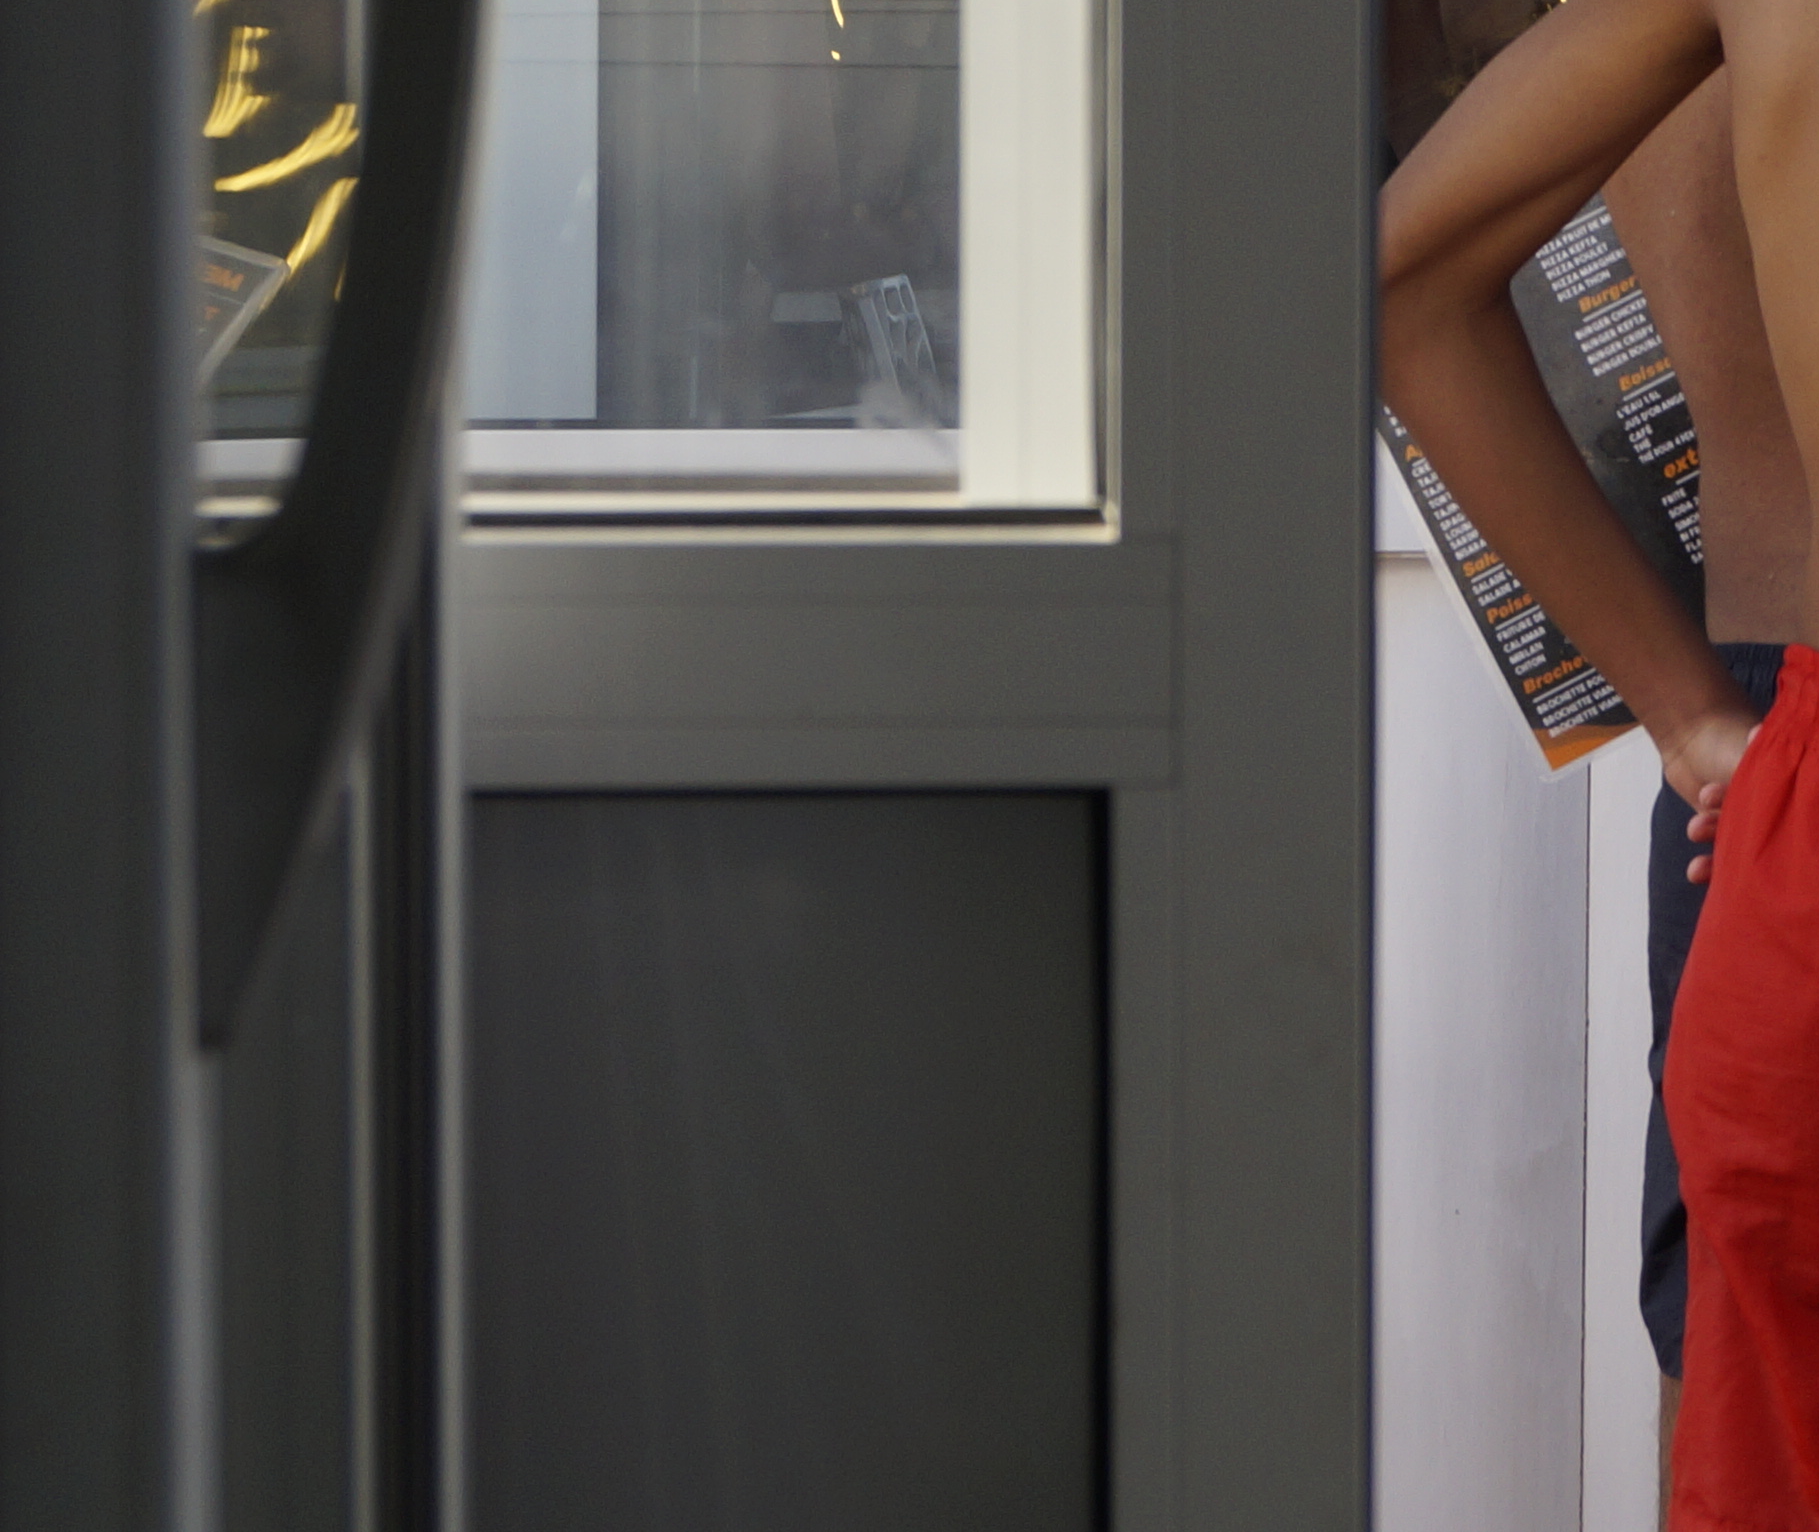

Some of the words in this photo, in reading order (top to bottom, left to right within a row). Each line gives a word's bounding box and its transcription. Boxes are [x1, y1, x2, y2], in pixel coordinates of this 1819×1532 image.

[1541, 250, 1569, 269] PIZZA
[1569, 236, 1597, 255] KEFTA
[1546, 261, 1574, 280] PIZZA
[1574, 243, 1607, 266] POULET
[1552, 273, 1579, 291] PIZZA
[1557, 283, 1585, 302] PIZZA
[1585, 271, 1610, 287] THON
[1579, 274, 1637, 312] Burger
[1575, 317, 1611, 340] BURGER
[1581, 329, 1616, 352] BURGER
[1617, 314, 1646, 333] KEFTA
[1587, 342, 1623, 365] BURGER
[1593, 353, 1628, 376] BURGER
[1523, 652, 1588, 694] Broche
[1537, 684, 1586, 714] BROCHETTE
[1543, 695, 1592, 726] BROCHETTE
